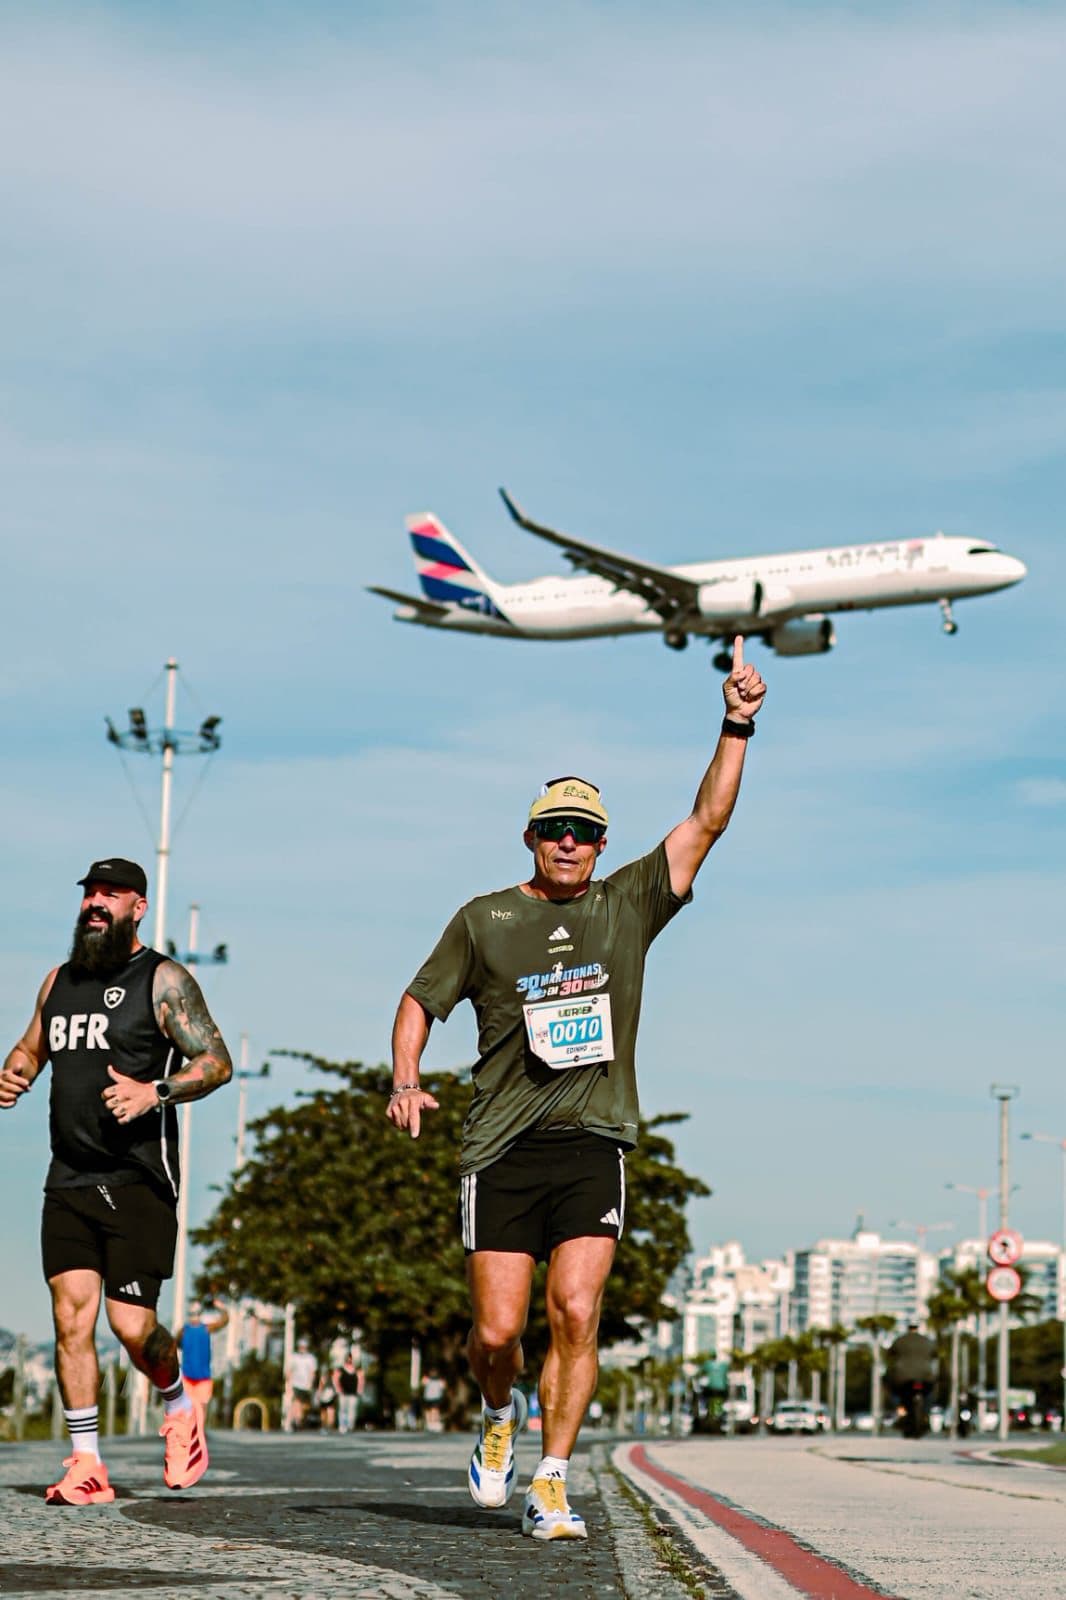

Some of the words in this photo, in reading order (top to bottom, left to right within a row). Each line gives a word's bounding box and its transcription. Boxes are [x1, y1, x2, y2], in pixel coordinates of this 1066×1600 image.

[516, 975, 540, 993] 30
[560, 979, 583, 996] 30
[49, 1013, 110, 1052] BFR
[552, 1018, 600, 1044] 0010
